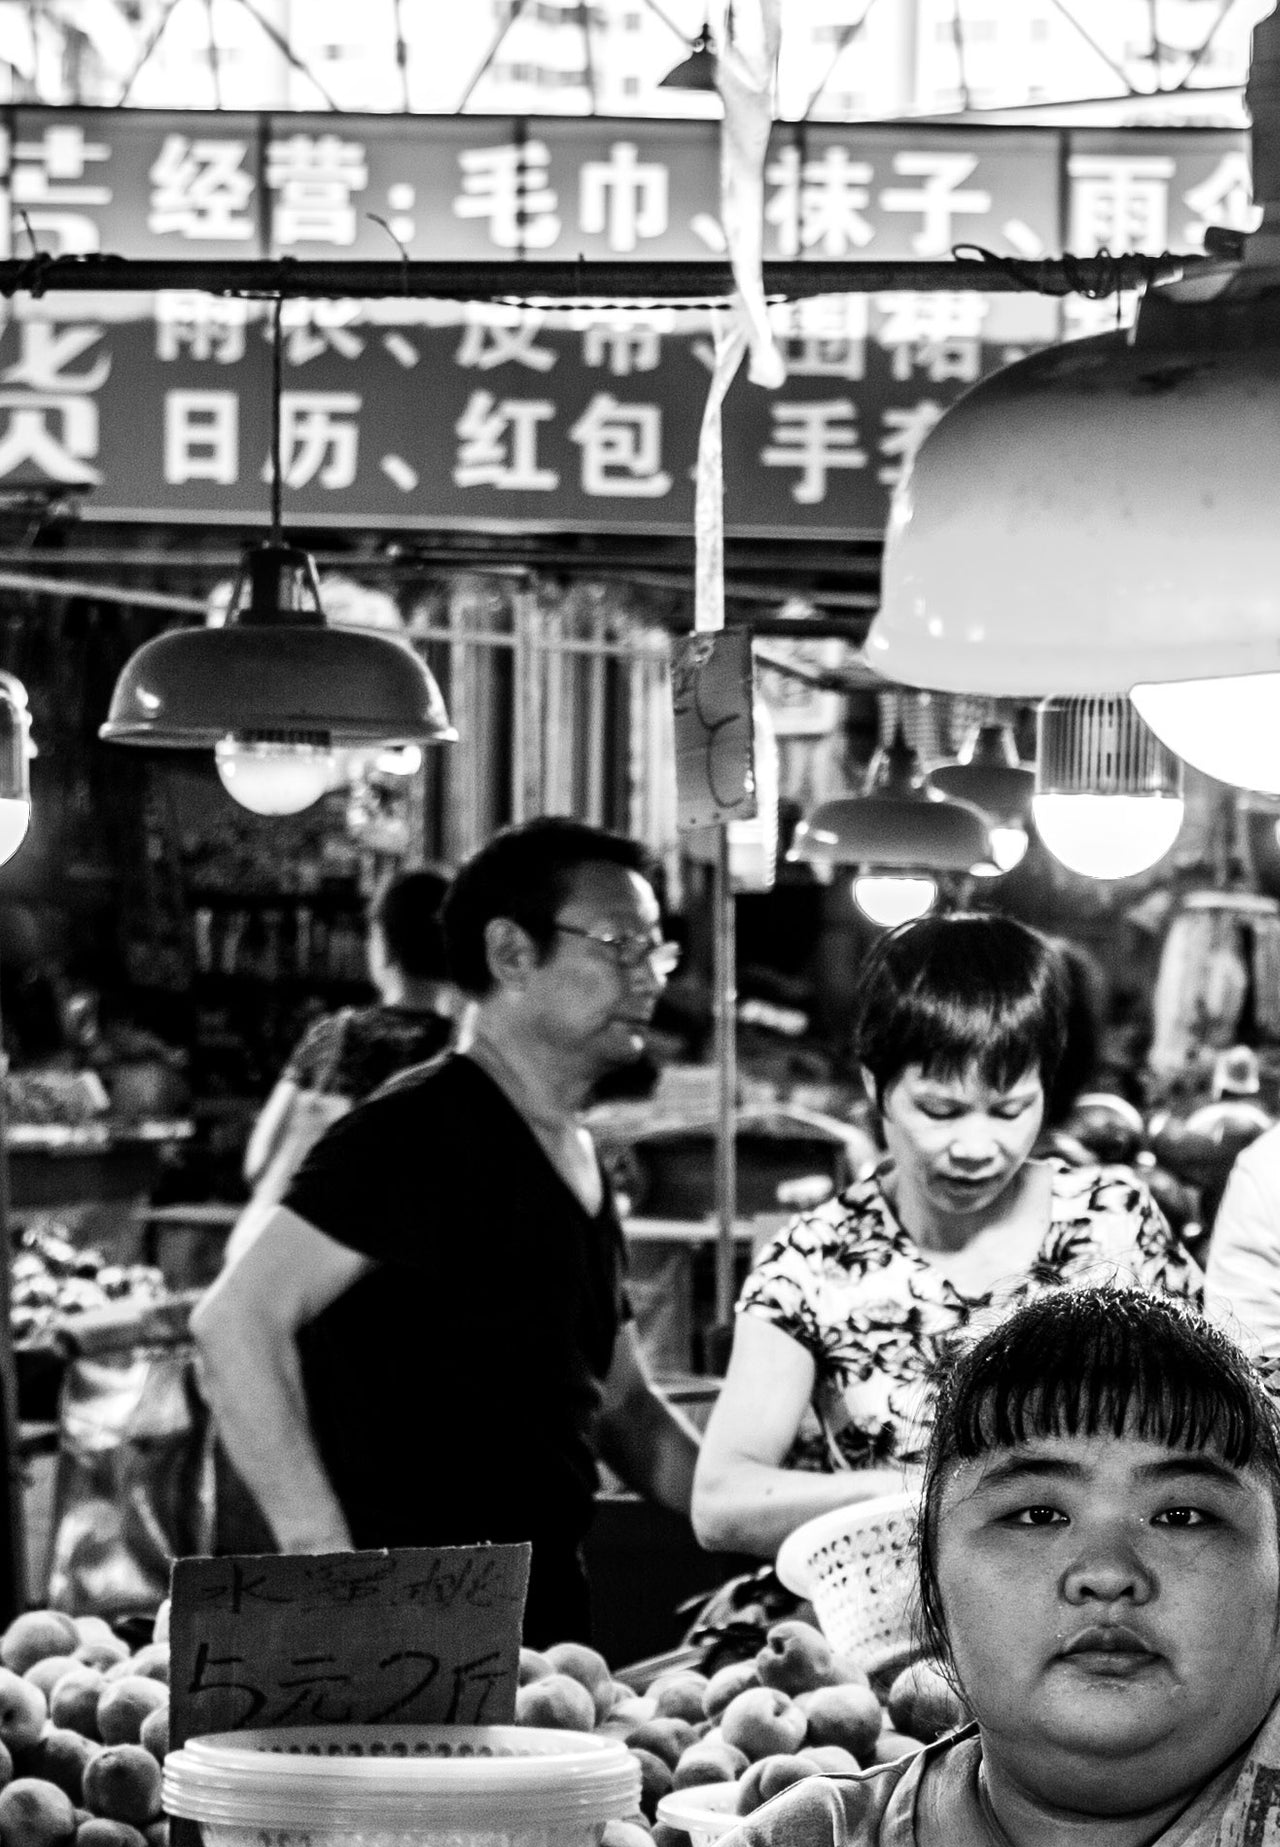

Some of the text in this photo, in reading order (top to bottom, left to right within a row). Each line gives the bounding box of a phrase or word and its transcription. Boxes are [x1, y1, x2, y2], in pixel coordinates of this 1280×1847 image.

[162, 390, 952, 504] 日历、红包手
[187, 1643, 507, 1730] 5元2斤
